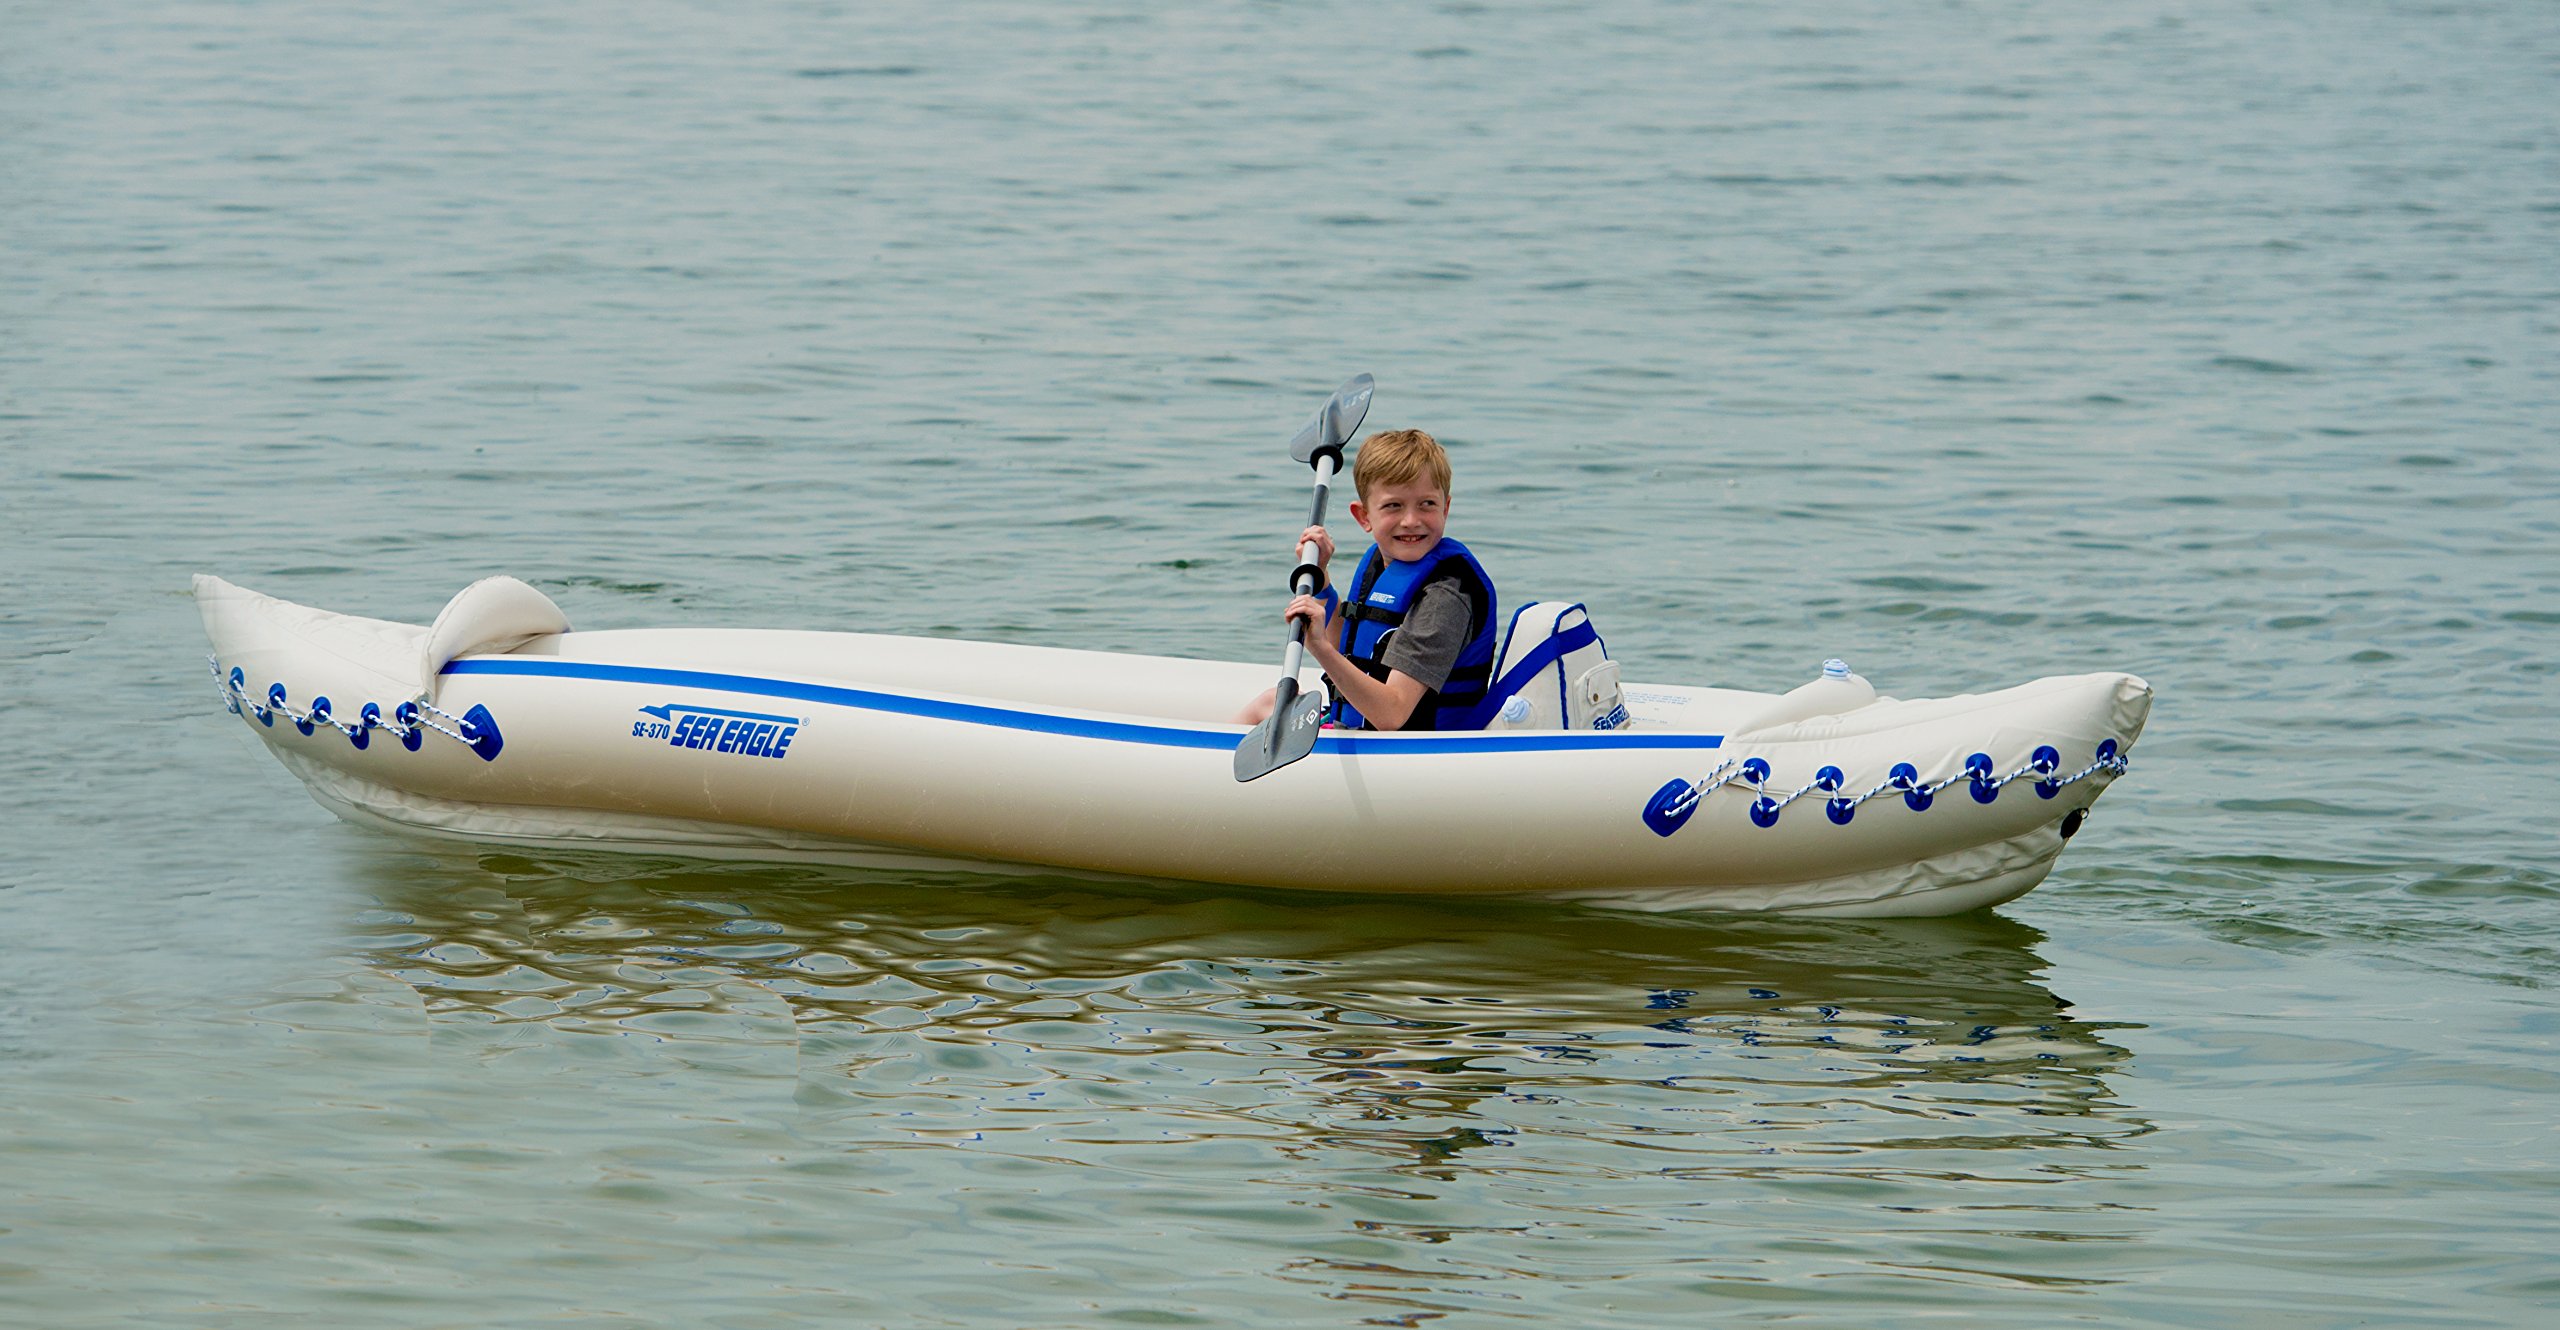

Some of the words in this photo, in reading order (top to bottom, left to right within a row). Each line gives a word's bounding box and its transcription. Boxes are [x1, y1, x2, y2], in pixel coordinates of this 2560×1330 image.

[632, 721, 670, 739] SE-370
[670, 714, 725, 751] SEA
[717, 720, 798, 759] EAGLE
